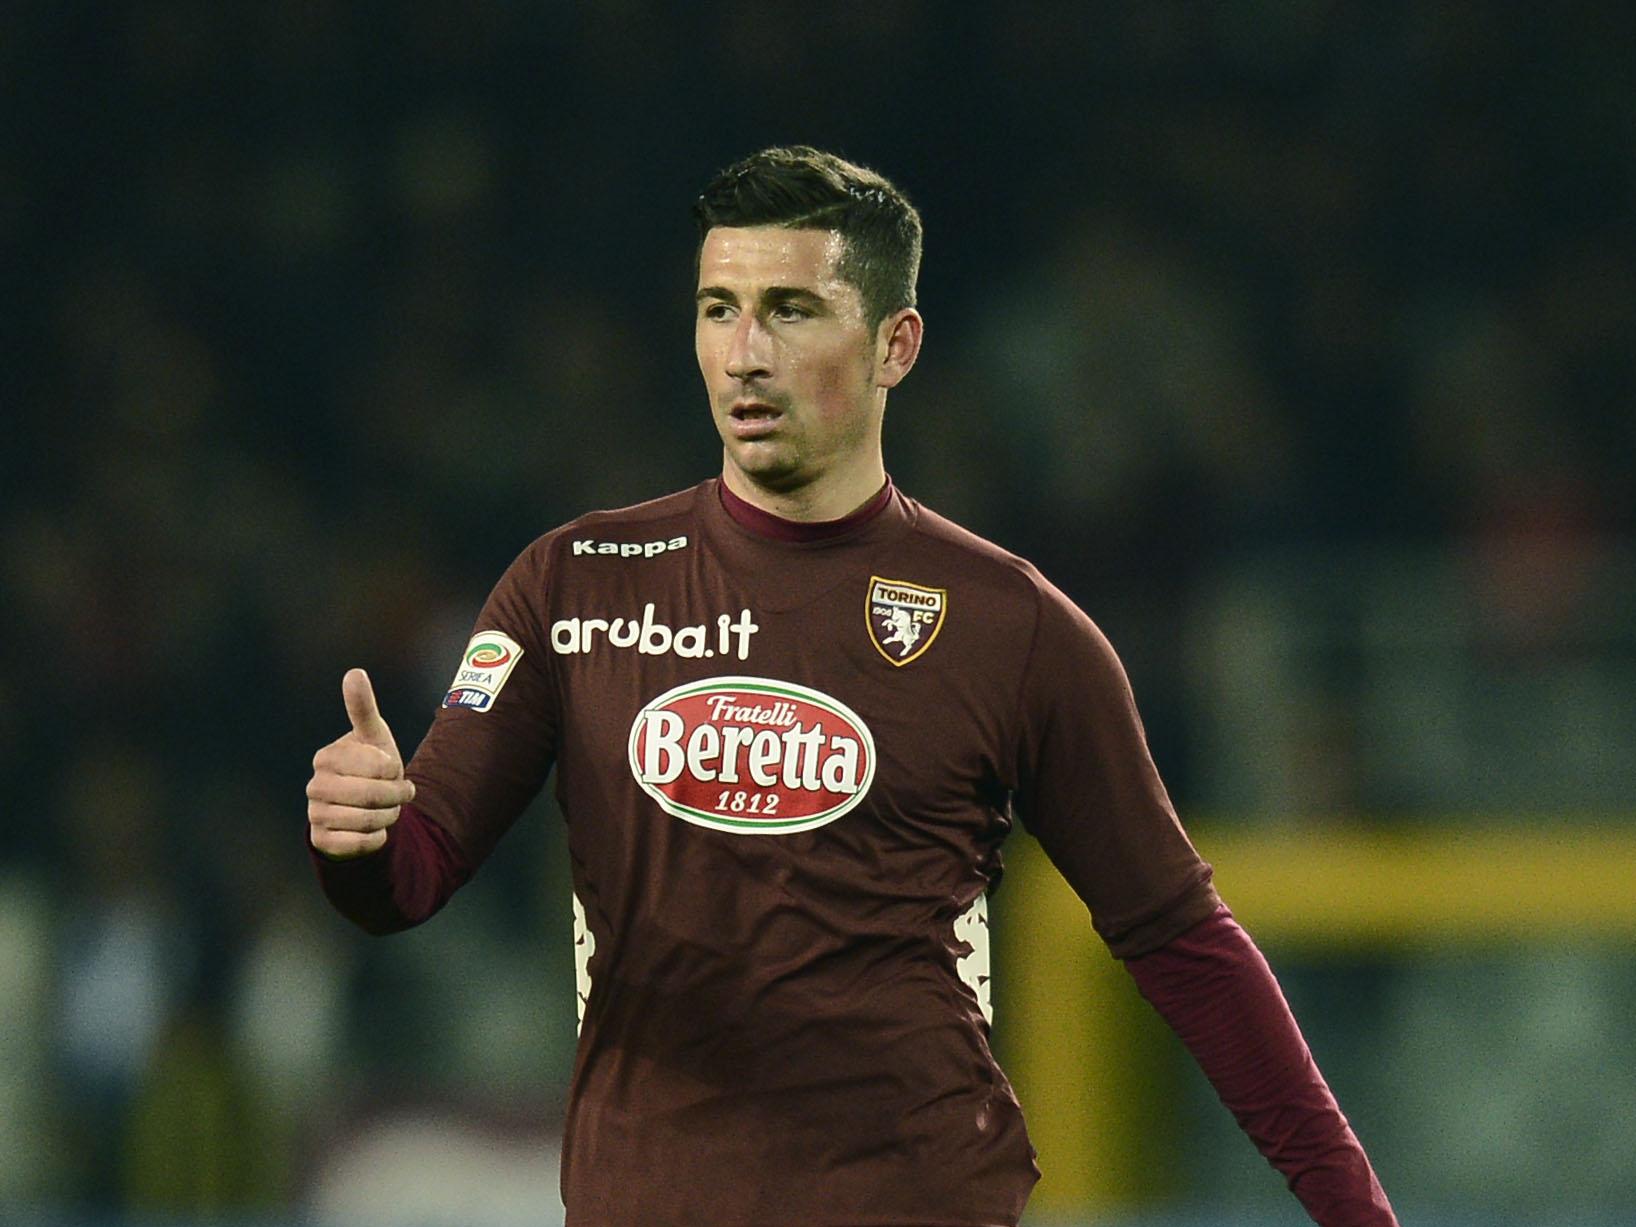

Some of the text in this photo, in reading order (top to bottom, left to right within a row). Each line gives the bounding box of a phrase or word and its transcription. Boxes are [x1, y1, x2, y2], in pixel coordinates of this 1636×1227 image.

[573, 536, 688, 557] Kappa
[878, 588, 936, 606] TORINO
[912, 611, 935, 624] FC
[551, 603, 759, 661] aruba.it
[459, 671, 493, 685] SERIE A
[459, 691, 486, 706] TIM
[707, 695, 797, 725] Fratelli
[642, 709, 859, 794] Beretta
[715, 790, 779, 815] 1812
